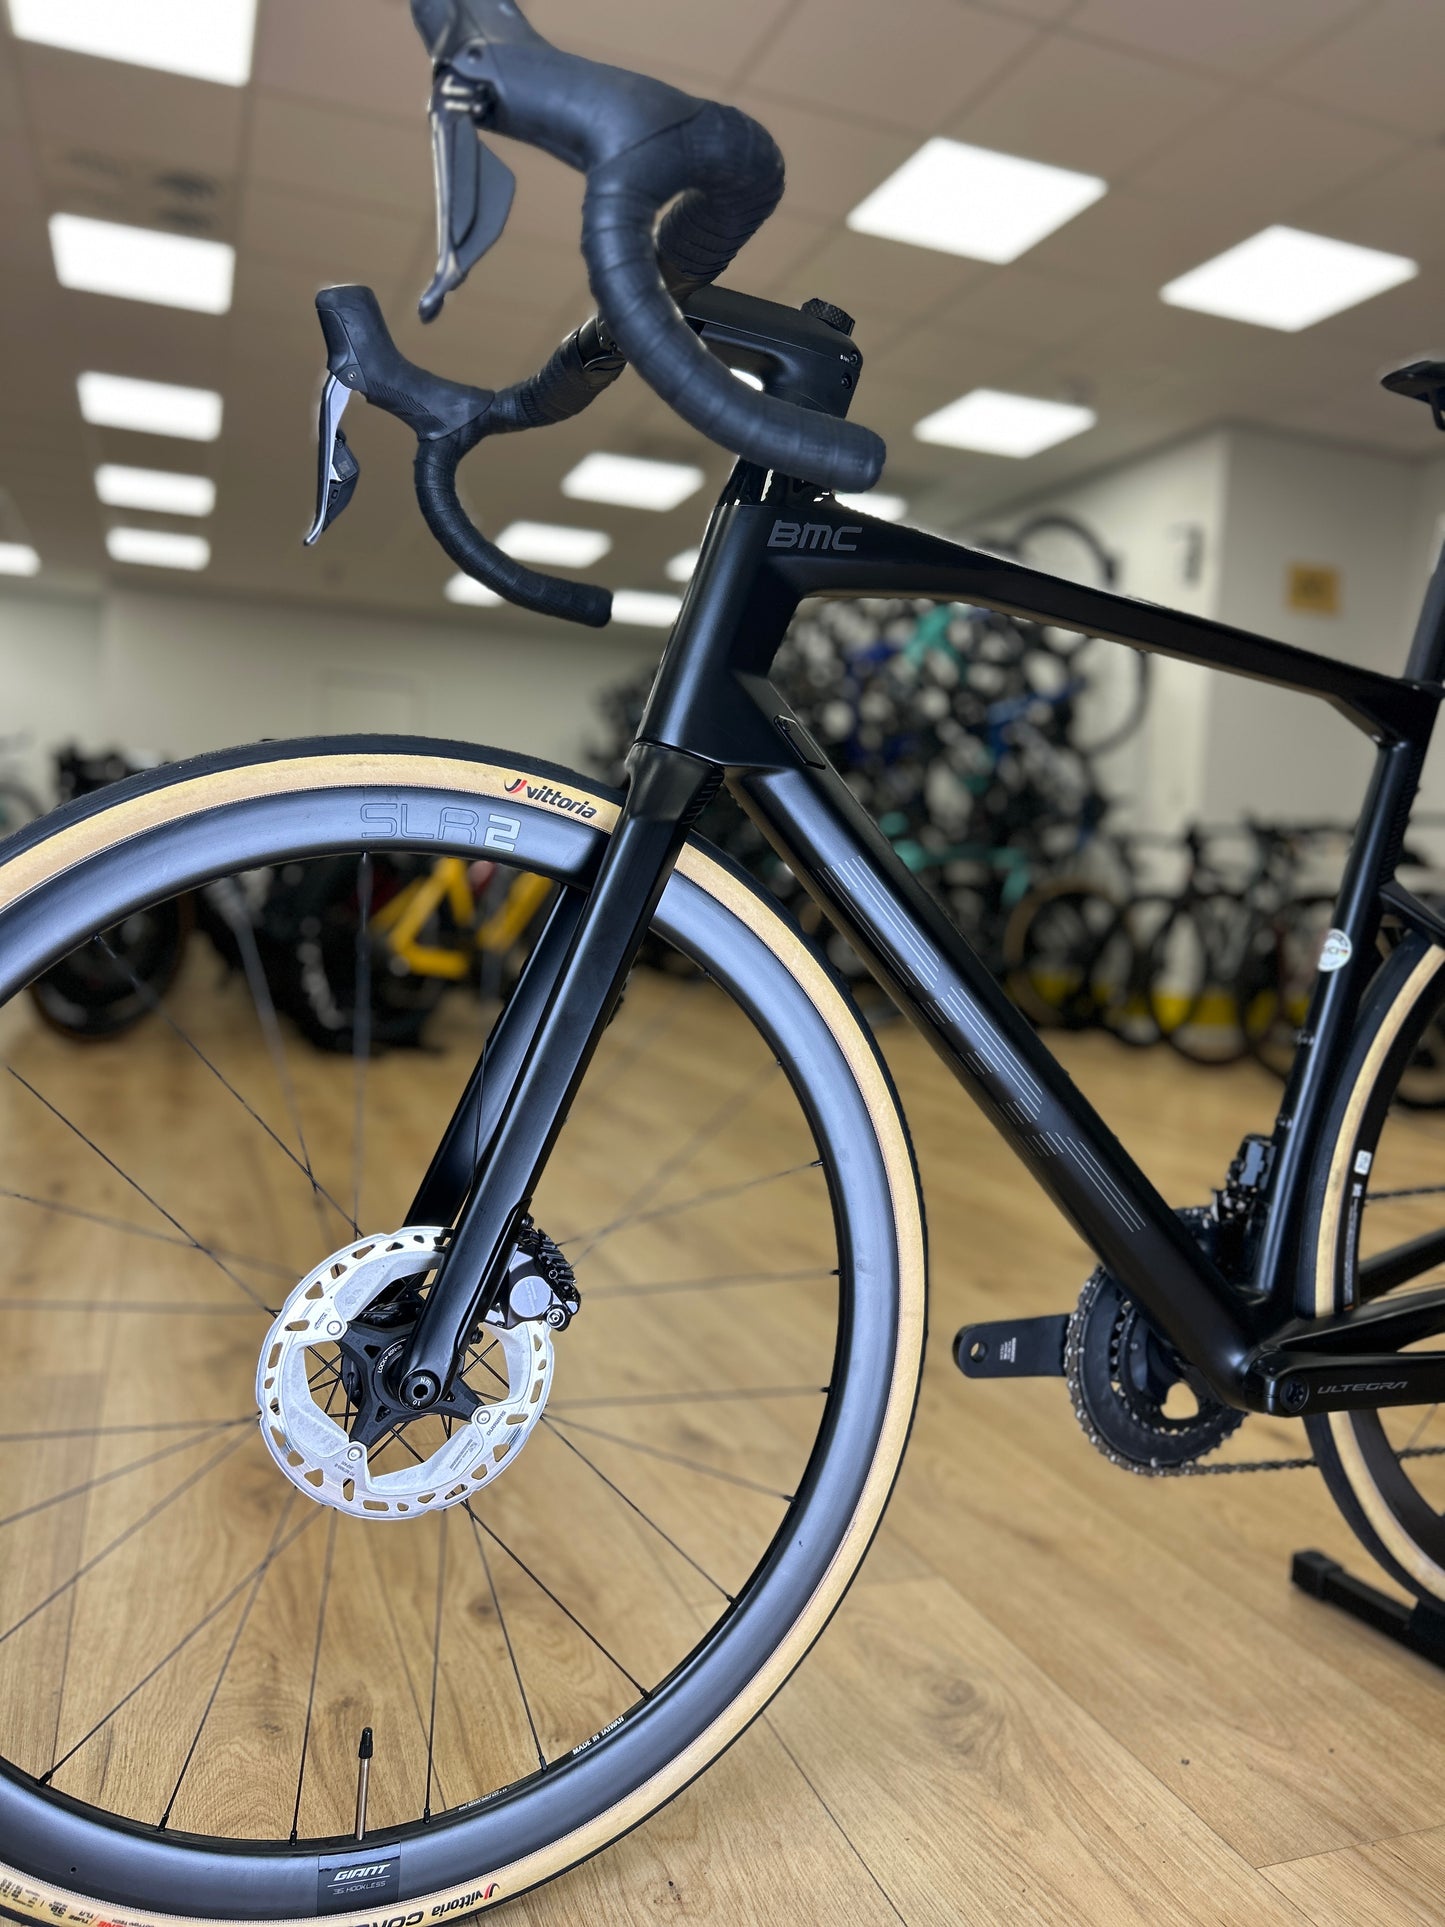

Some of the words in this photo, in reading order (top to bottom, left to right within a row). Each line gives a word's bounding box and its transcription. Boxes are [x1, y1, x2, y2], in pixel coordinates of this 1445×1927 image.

[767, 520, 862, 551] BMC
[526, 785, 597, 819] vittoria
[1317, 1381, 1408, 1394] ULTEGRA
[572, 1739, 592, 1755] MADE
[591, 1733, 600, 1742] IN
[600, 1715, 624, 1736] TAIWAN
[333, 1863, 391, 1881] GIANT
[346, 1881, 386, 1892] HOOKLESS
[431, 1890, 483, 1917] vittoria
